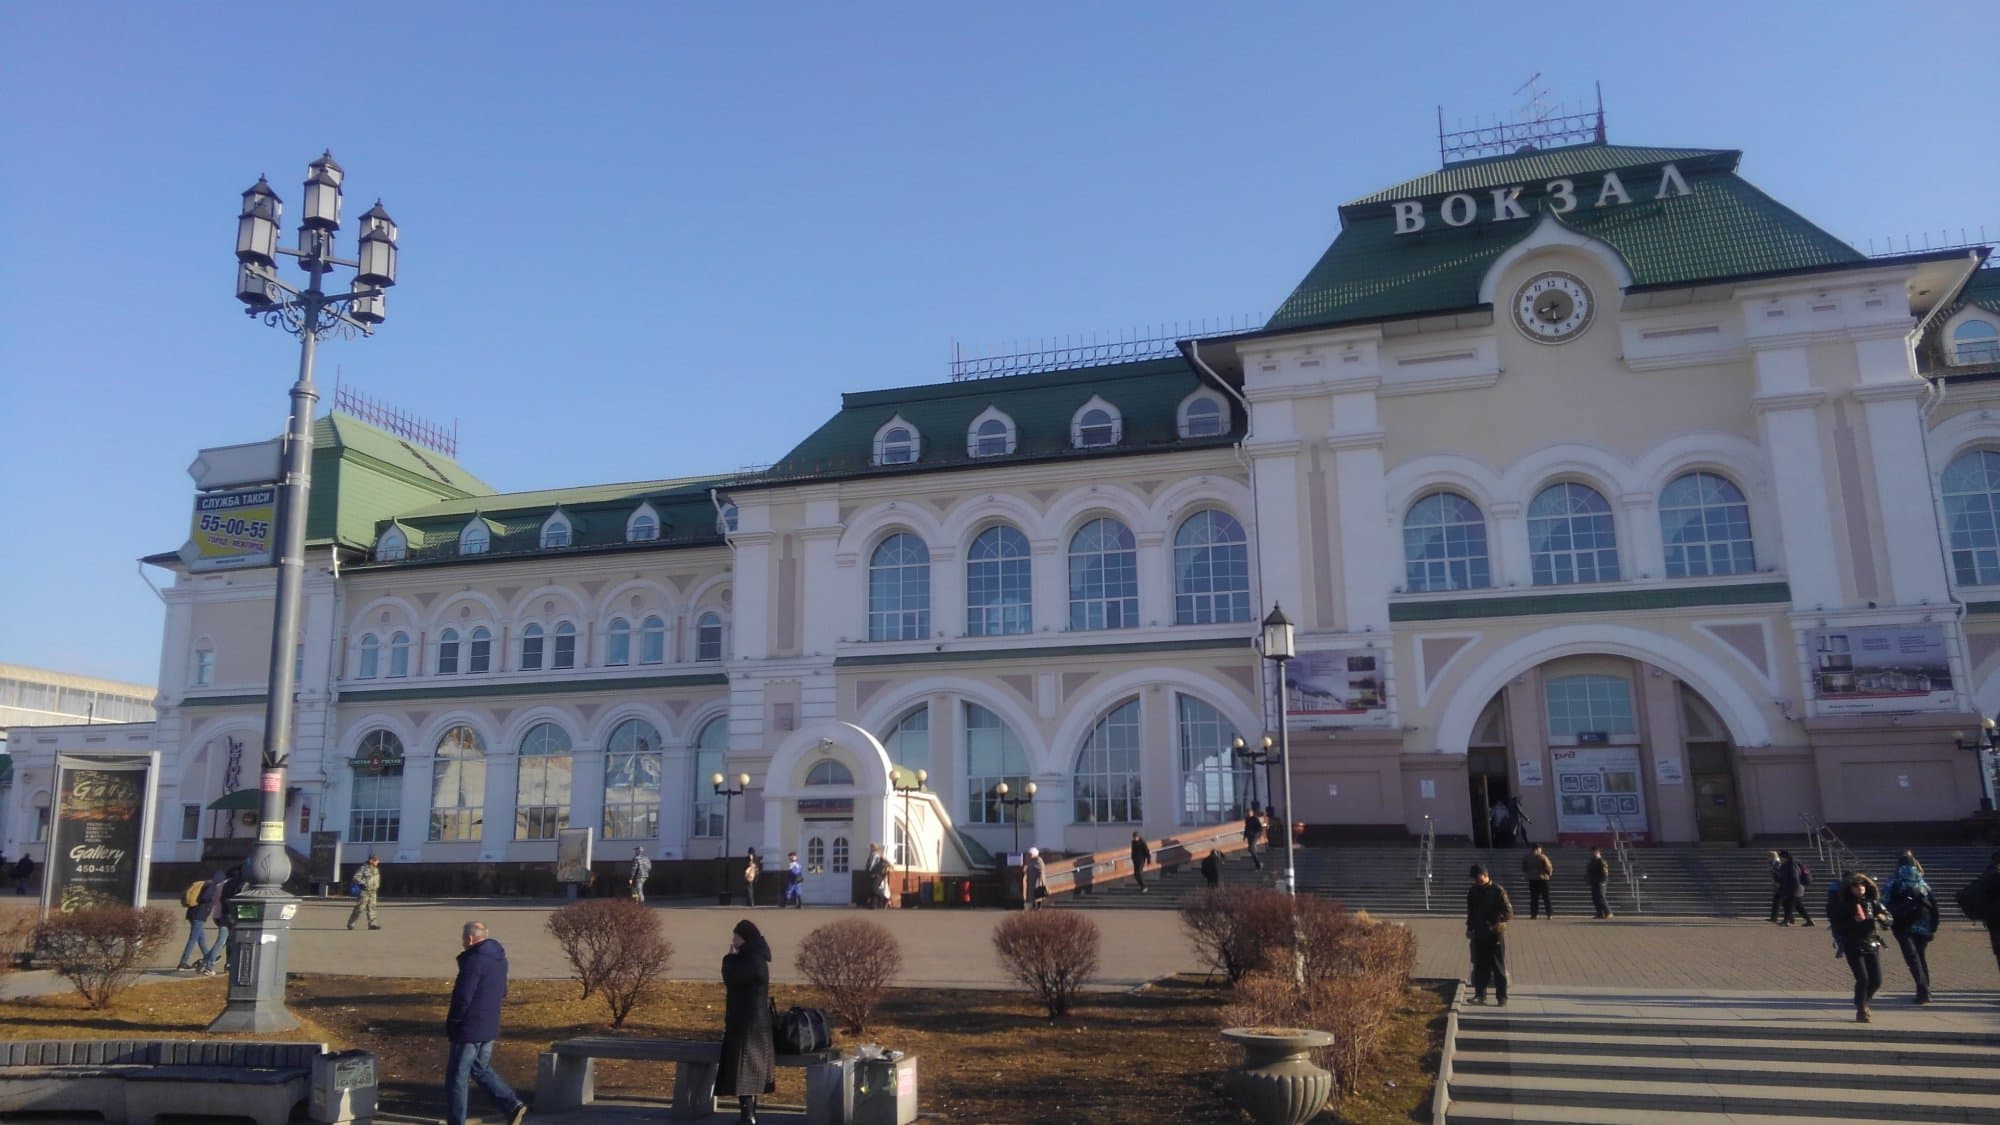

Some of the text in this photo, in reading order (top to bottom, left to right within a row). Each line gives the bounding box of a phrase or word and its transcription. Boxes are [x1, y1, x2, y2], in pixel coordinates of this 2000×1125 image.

[1391, 163, 1693, 235] ВОКЗАЛ
[202, 492, 270, 509] СЛУЖБА ТАКСИ
[200, 514, 268, 538] 55-00-55
[69, 844, 125, 866] Gallery
[75, 864, 116, 873] 450-455
